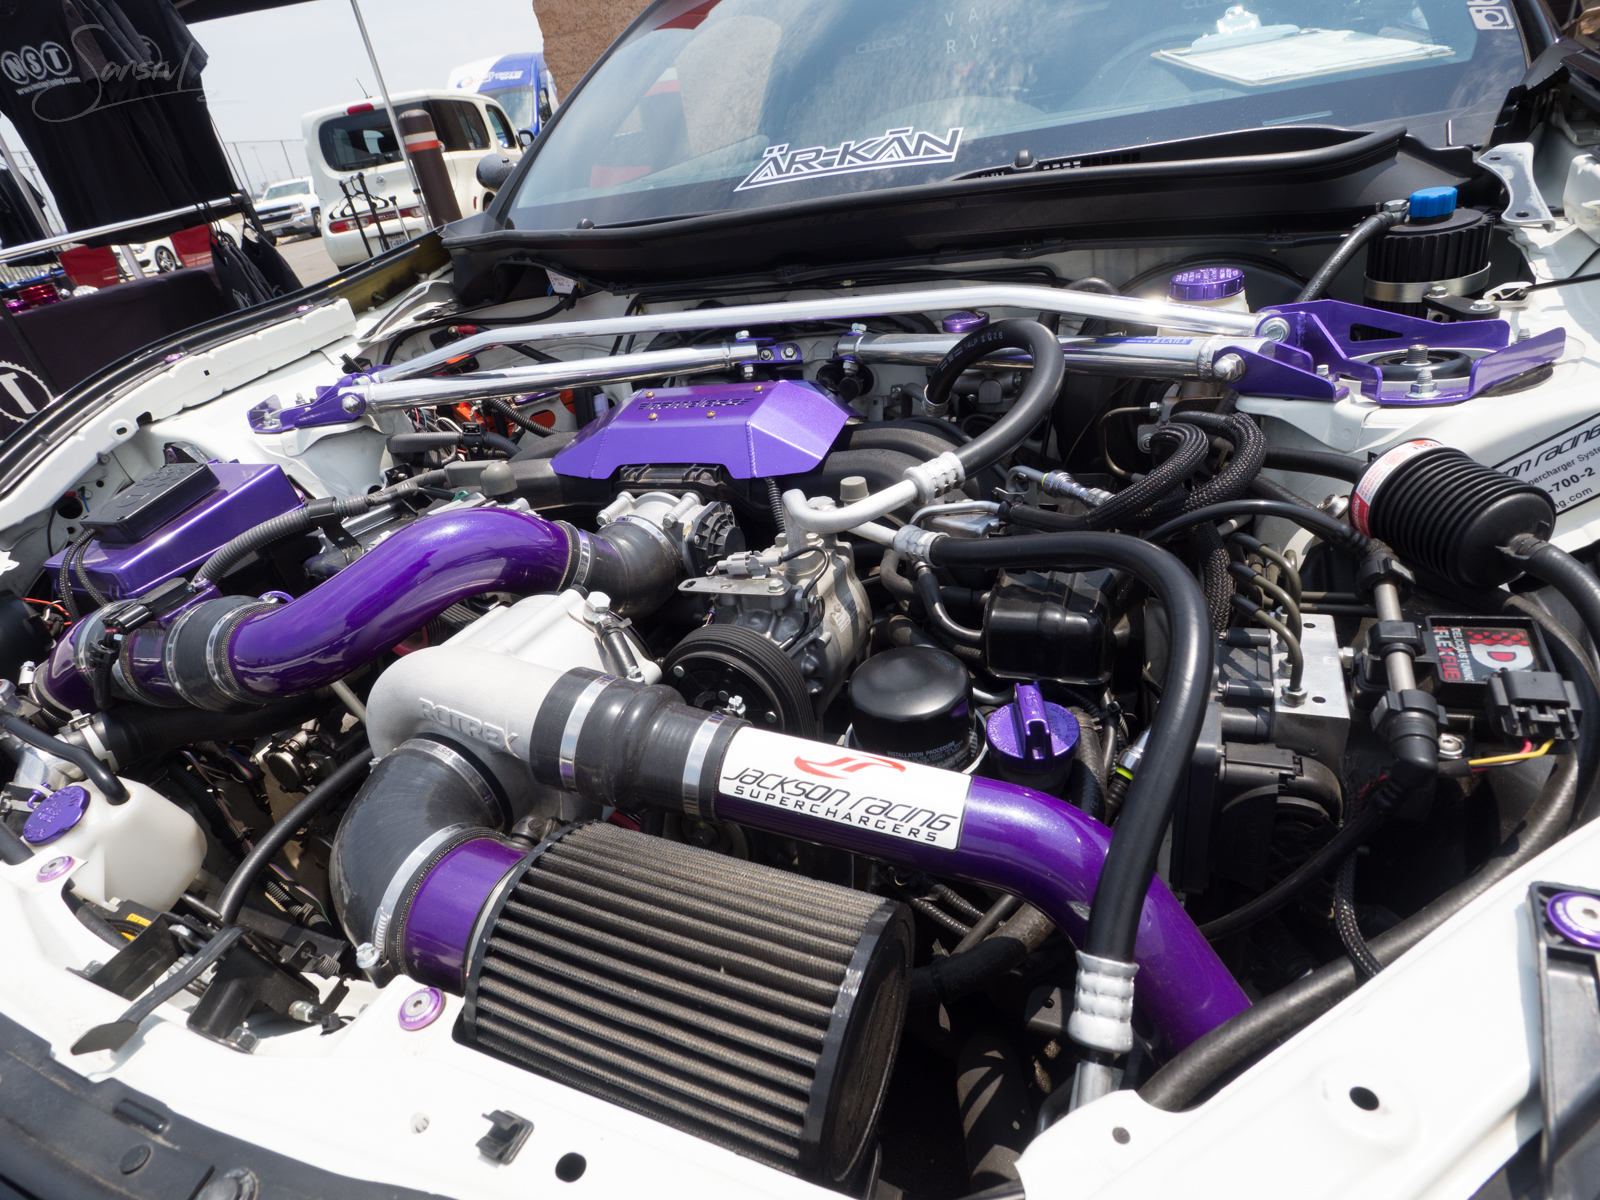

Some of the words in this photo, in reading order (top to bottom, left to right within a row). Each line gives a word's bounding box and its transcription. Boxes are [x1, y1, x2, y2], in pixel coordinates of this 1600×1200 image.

[419, 696, 519, 759] ROTREX
[887, 751, 925, 759] INSTALLATION
[926, 741, 956, 756] PROCEDURE
[734, 785, 938, 842] SUPERCHARGERS
